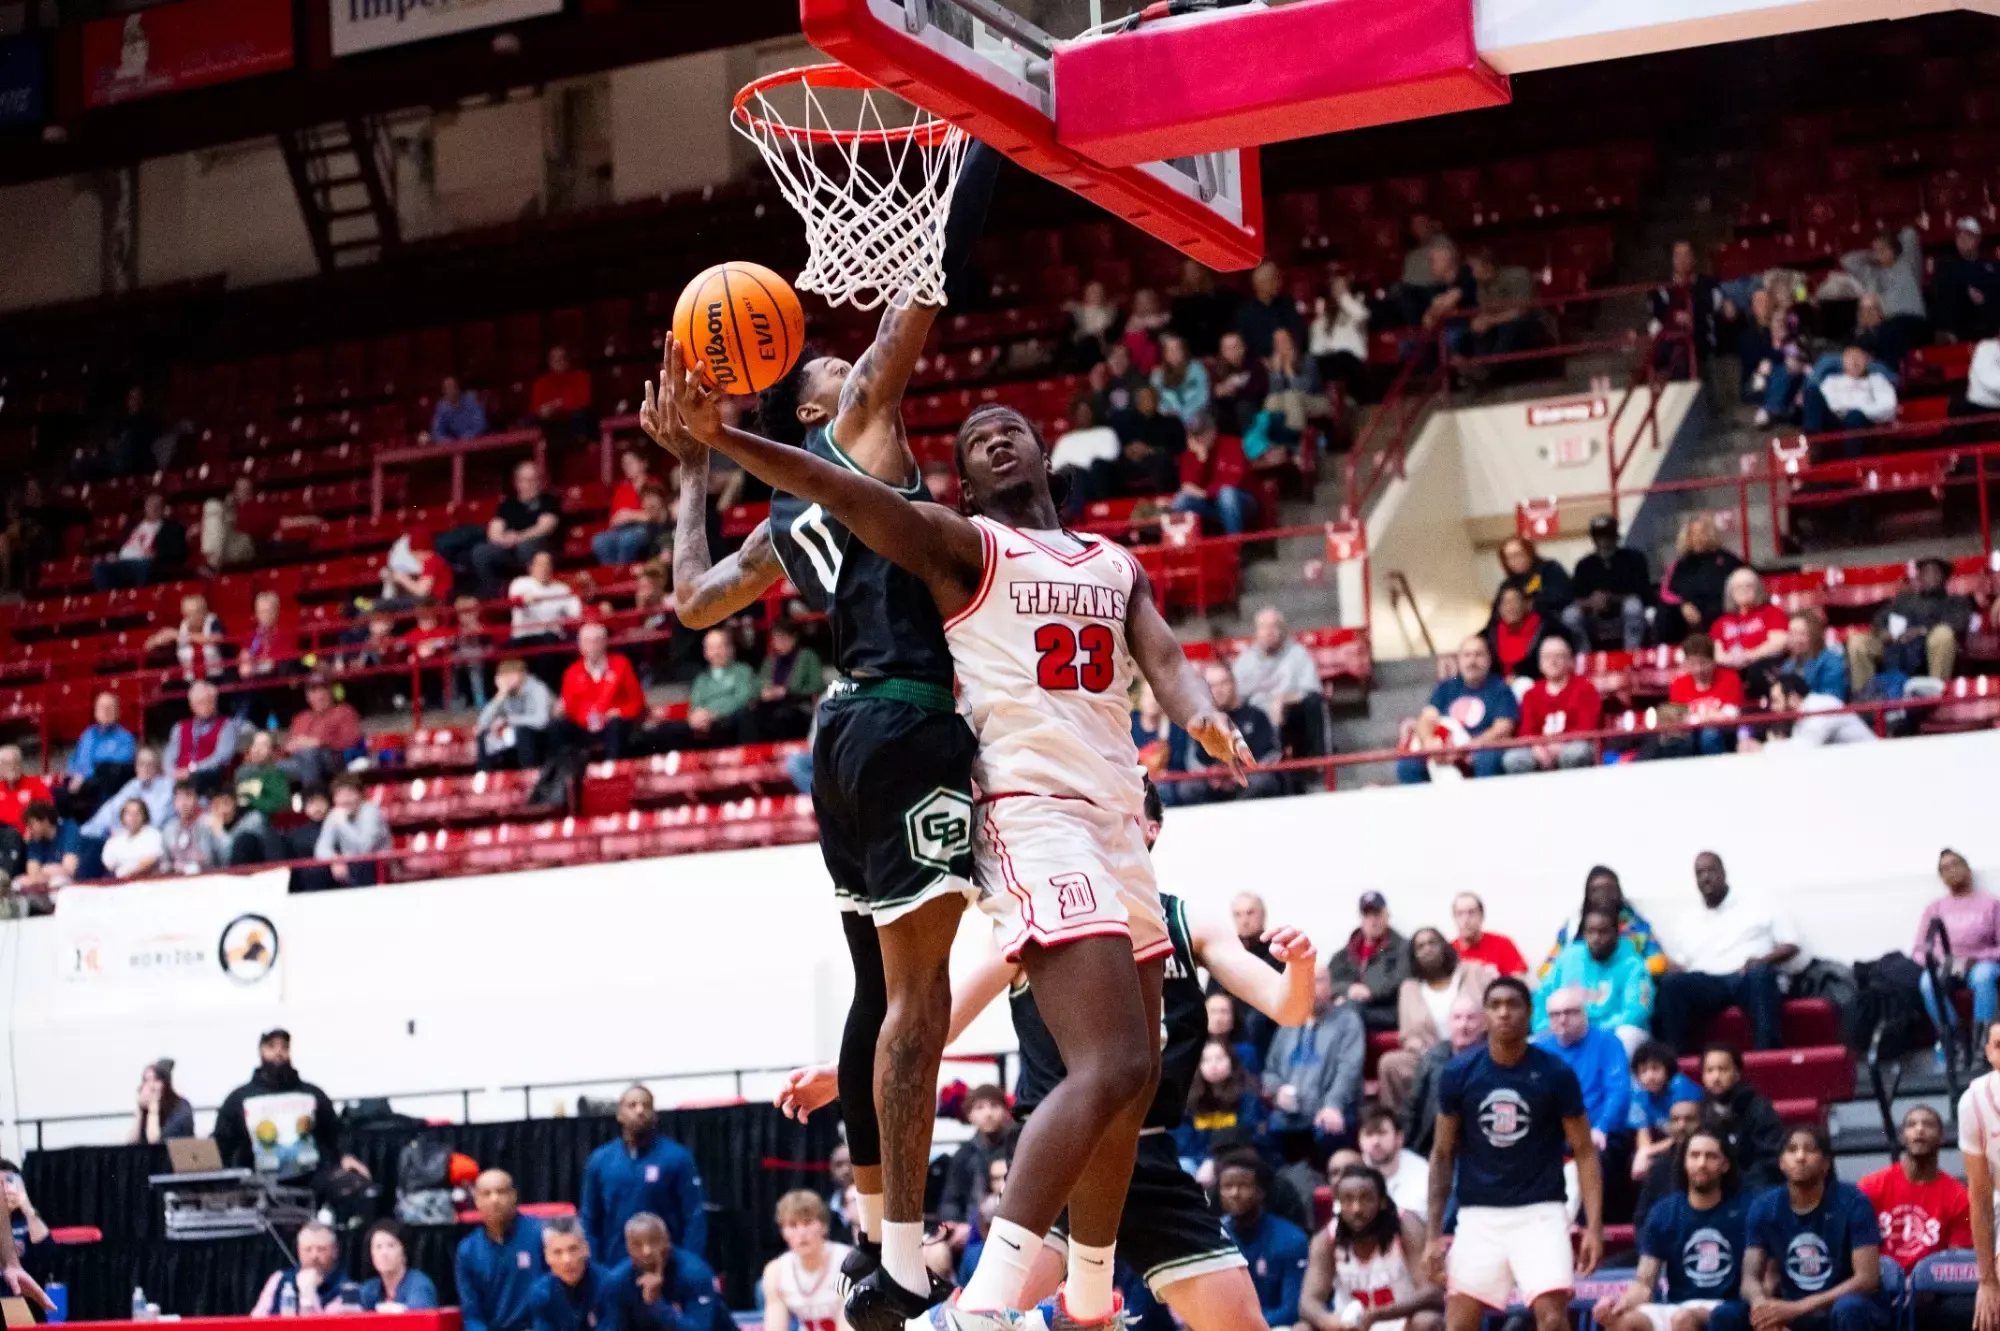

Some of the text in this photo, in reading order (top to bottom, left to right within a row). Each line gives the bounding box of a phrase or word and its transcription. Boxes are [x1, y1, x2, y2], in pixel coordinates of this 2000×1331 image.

[705, 302, 738, 384] Wilson
[1010, 581, 1126, 620] TITANS
[1034, 623, 1115, 693] 23
[921, 811, 967, 848] GB
